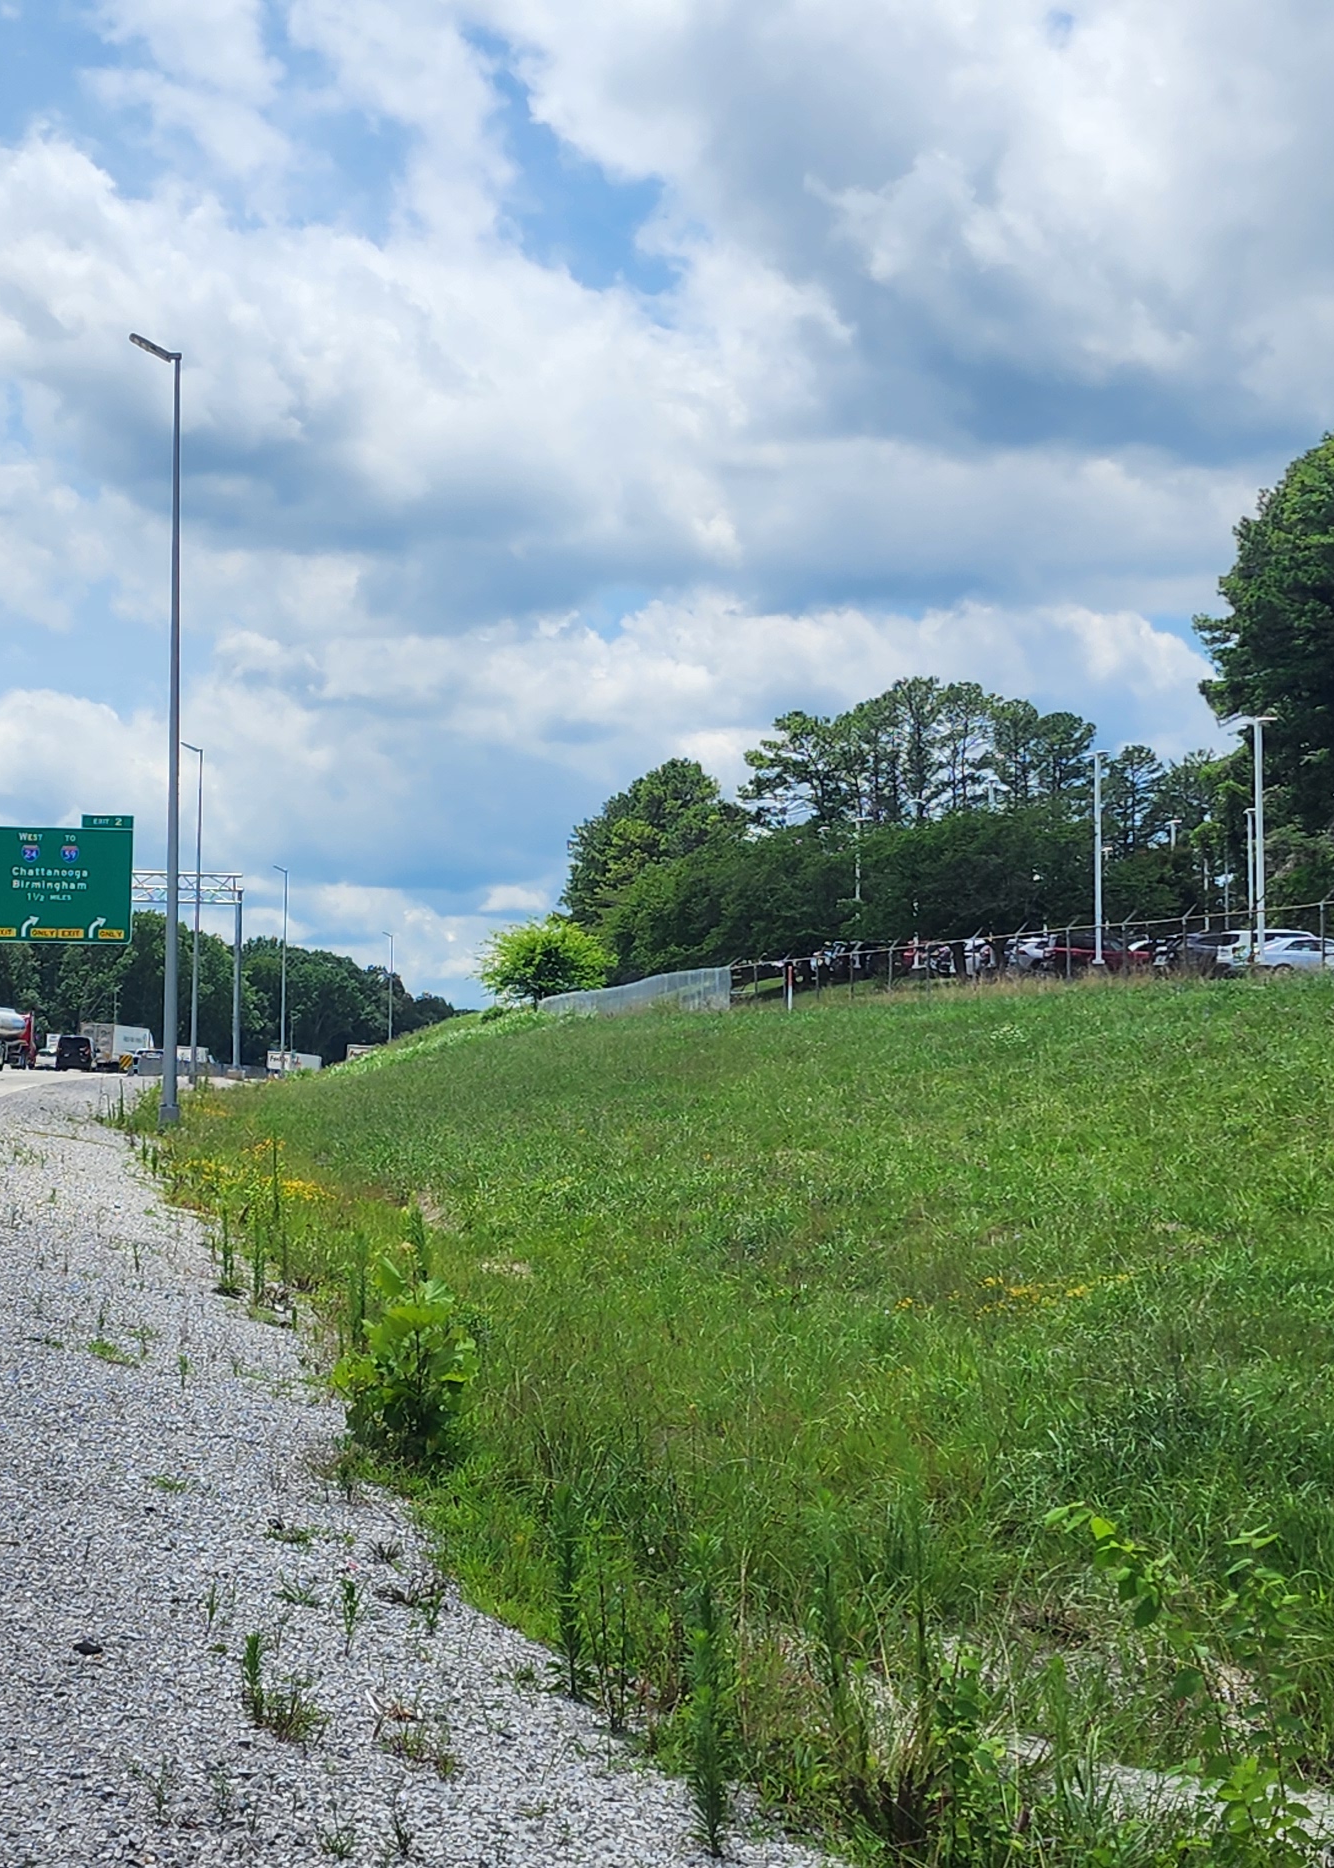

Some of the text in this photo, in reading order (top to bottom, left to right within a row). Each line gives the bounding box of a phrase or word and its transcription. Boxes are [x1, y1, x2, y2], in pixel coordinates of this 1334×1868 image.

[115, 817, 123, 826] 2
[18, 832, 76, 842] WEST TO
[24, 849, 37, 859] 24
[64, 850, 76, 859] 59
[11, 866, 88, 879] Chattanooga
[11, 879, 87, 892] Birmingham
[61, 929, 81, 937] EXIT
